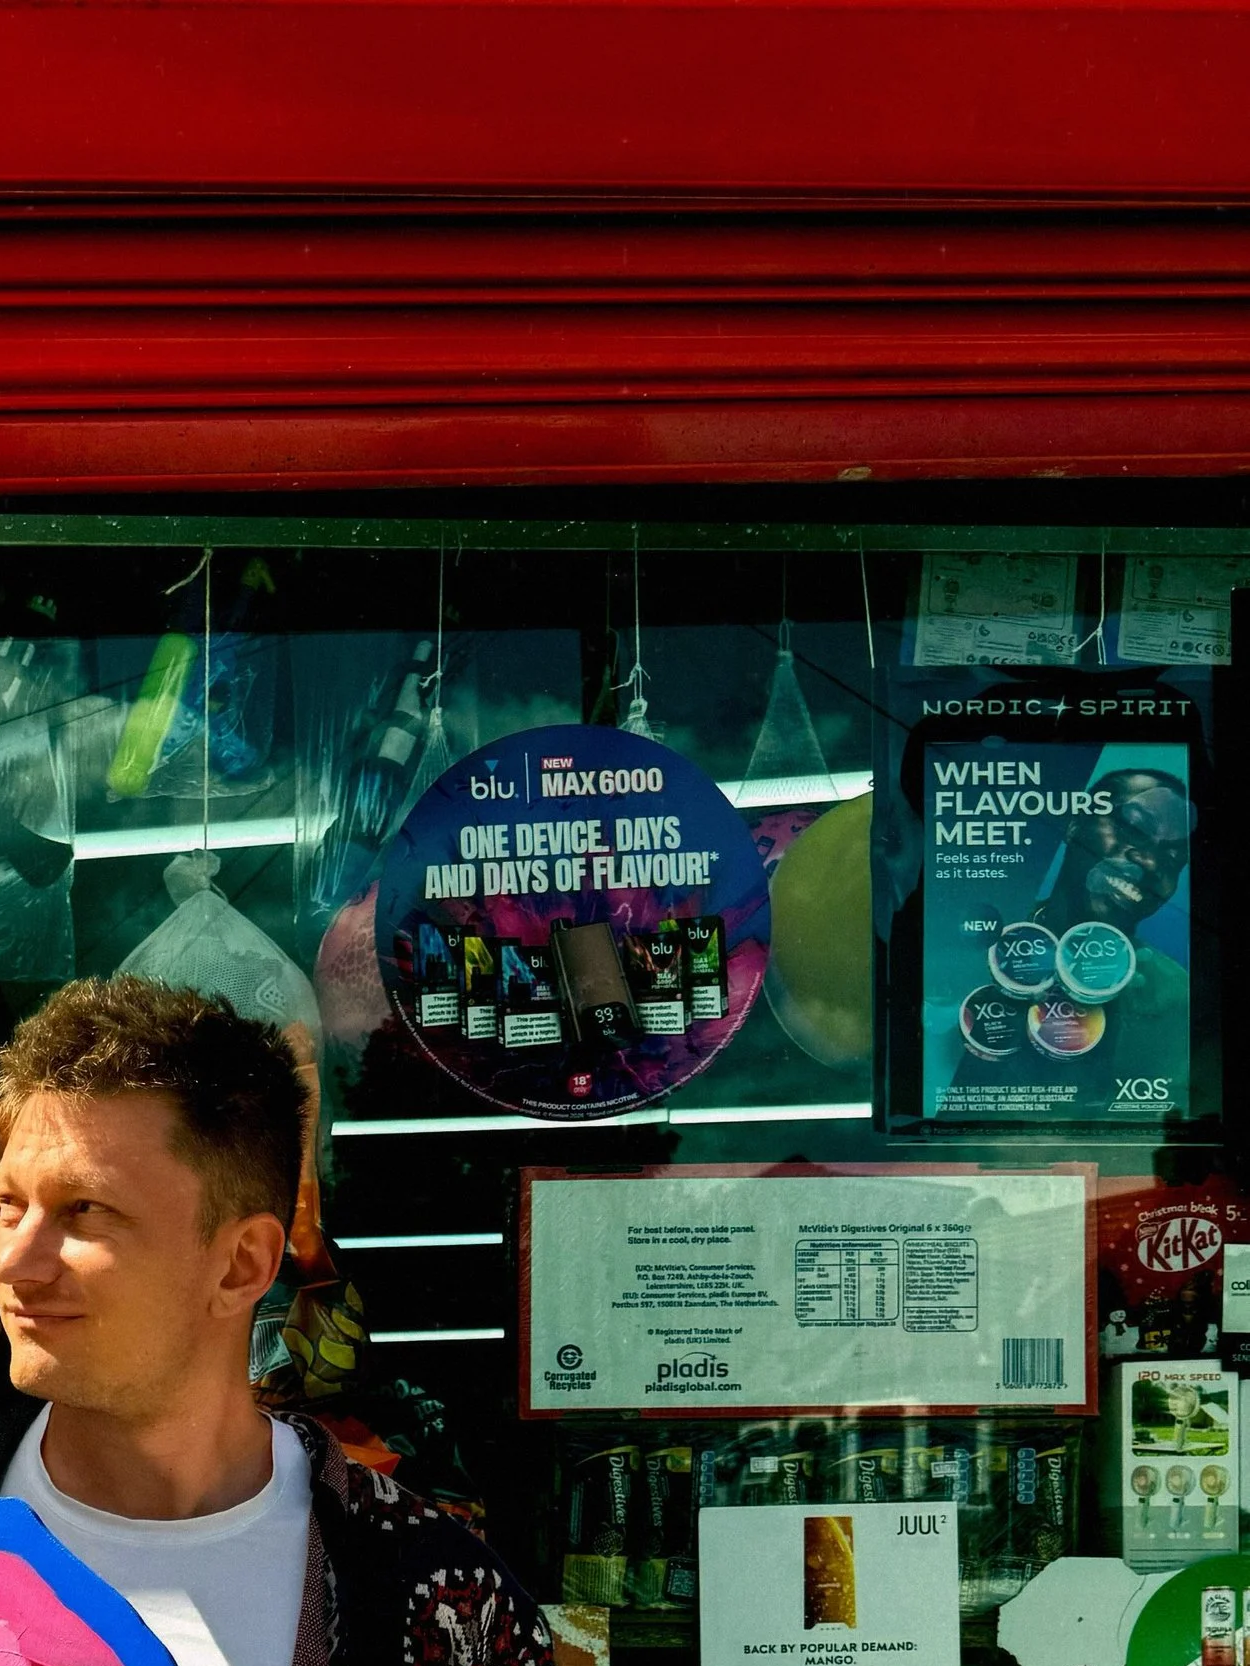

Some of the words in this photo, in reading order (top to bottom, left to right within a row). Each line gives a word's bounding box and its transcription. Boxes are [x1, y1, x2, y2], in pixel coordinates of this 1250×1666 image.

[923, 700, 1042, 715] NORDIC
[1080, 700, 1191, 716] SPIRIT
[543, 758, 572, 768] NEW
[542, 771, 596, 797] MAX
[599, 767, 663, 795] 6000
[934, 762, 1041, 786] WHEN
[470, 775, 516, 800] blu
[935, 791, 1113, 816] FLAVOURS
[461, 824, 509, 860] ONE
[516, 820, 610, 857] DEVICE.
[616, 816, 681, 852] DAYS
[935, 821, 1032, 845] MEET.
[936, 853, 970, 864] Feels
[973, 855, 987, 864] as
[990, 853, 1024, 864] fresh
[424, 863, 476, 899] AND
[483, 860, 549, 897] DAYS
[555, 857, 586, 892] OF
[936, 870, 951, 879] as
[953, 868, 963, 879] it
[966, 868, 1008, 879] tastes.
[688, 928, 709, 940] blu
[964, 921, 997, 931] NEW
[652, 943, 673, 955] blu
[1003, 939, 1046, 957] XQS
[1072, 940, 1117, 959] XQS
[595, 1007, 614, 1023] 99
[1044, 1001, 1088, 1019] XQS
[1116, 1078, 1169, 1100] XQS
[522, 1098, 537, 1107] THIS
[538, 1101, 571, 1111] PRODUCT
[571, 1101, 606, 1110] CONTAINS
[1138, 1203, 1187, 1221] Christmas
[1191, 1202, 1218, 1215] break
[664, 1226, 693, 1235] before,
[711, 1225, 728, 1233] side
[799, 1224, 839, 1233] McVitie's
[841, 1224, 887, 1234] Digestives
[889, 1224, 925, 1233] Original
[691, 1236, 705, 1245] dry
[707, 1236, 731, 1245] place.
[1147, 1219, 1219, 1271] KitKat
[655, 1328, 692, 1336] Registered
[544, 1371, 597, 1382] Corrugated
[657, 1356, 729, 1383] pladis
[1138, 1371, 1161, 1381] 120
[549, 1381, 592, 1392] Recycles
[645, 1382, 742, 1394] pladisglobal.com
[609, 1456, 627, 1524] Digestives
[646, 1457, 663, 1527] Digestives
[1047, 1456, 1065, 1526] Digestives
[744, 1644, 776, 1654] BACK
[781, 1644, 795, 1654] BY
[800, 1643, 857, 1653] POPULAR
[861, 1642, 917, 1652] DEMAND:
[805, 1656, 857, 1666] MANGO.
